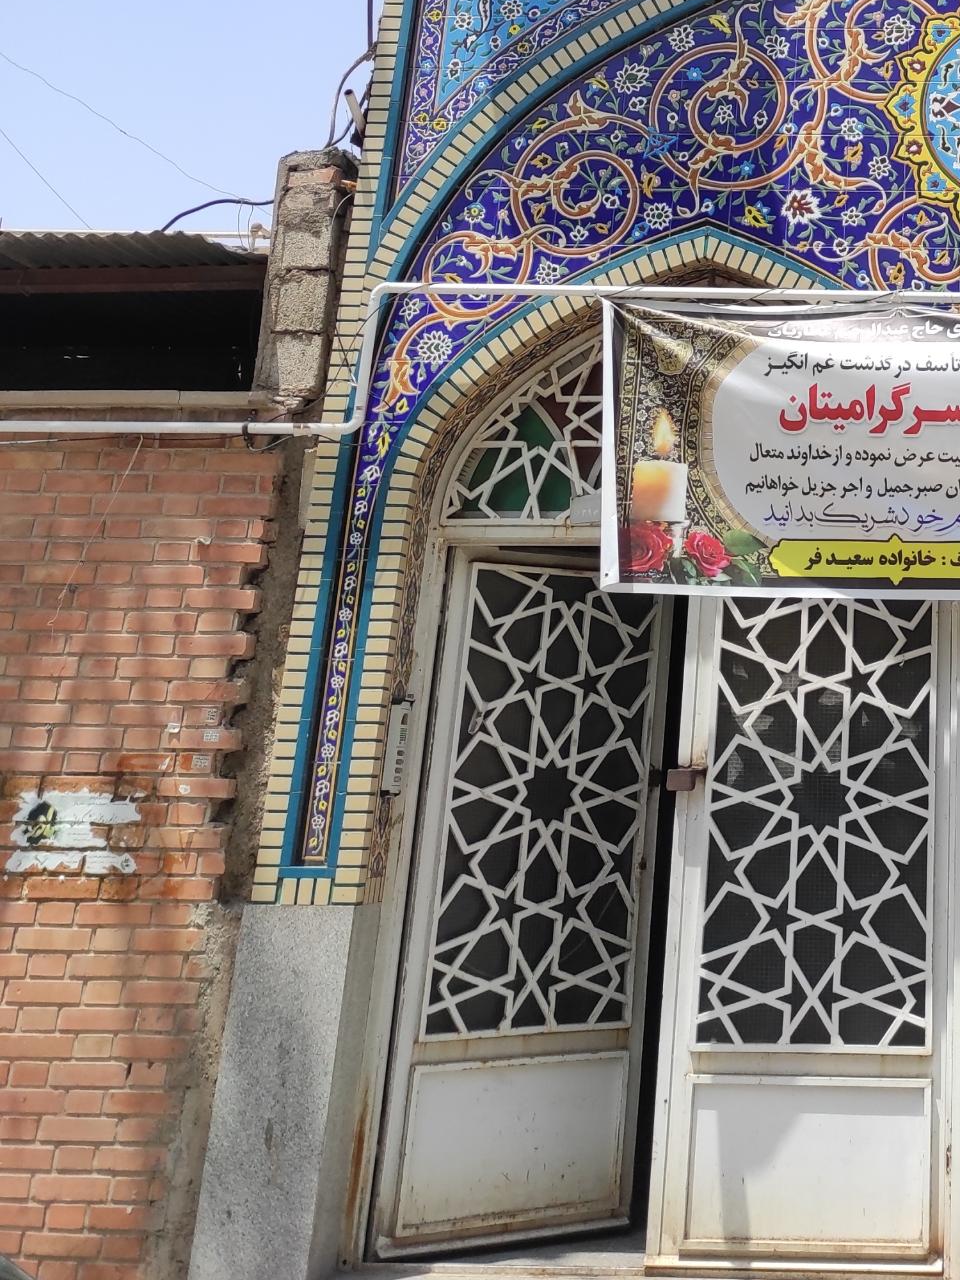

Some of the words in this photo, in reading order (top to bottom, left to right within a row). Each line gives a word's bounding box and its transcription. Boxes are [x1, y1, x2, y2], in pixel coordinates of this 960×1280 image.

[912, 320, 943, 340] حاج
[763, 351, 809, 377] انگیز
[812, 354, 835, 376] غم
[779, 382, 912, 434] گرامیتان
[750, 442, 785, 463] متعال
[787, 439, 832, 467] خداوند
[832, 440, 844, 467] از
[845, 452, 853, 466] و
[854, 447, 892, 467] نموده
[894, 444, 935, 467] عرض
[745, 473, 799, 497] خواهانیم
[801, 475, 837, 498] جزیل
[840, 476, 863, 499] اجر
[866, 485, 873, 499] و
[877, 477, 915, 498] جمیل
[914, 482, 943, 501] صبر
[763, 501, 816, 528] بدانید
[820, 502, 897, 532] شریک
[804, 547, 823, 570] فر
[826, 554, 874, 570] سعید
[879, 549, 936, 571] خانواده
